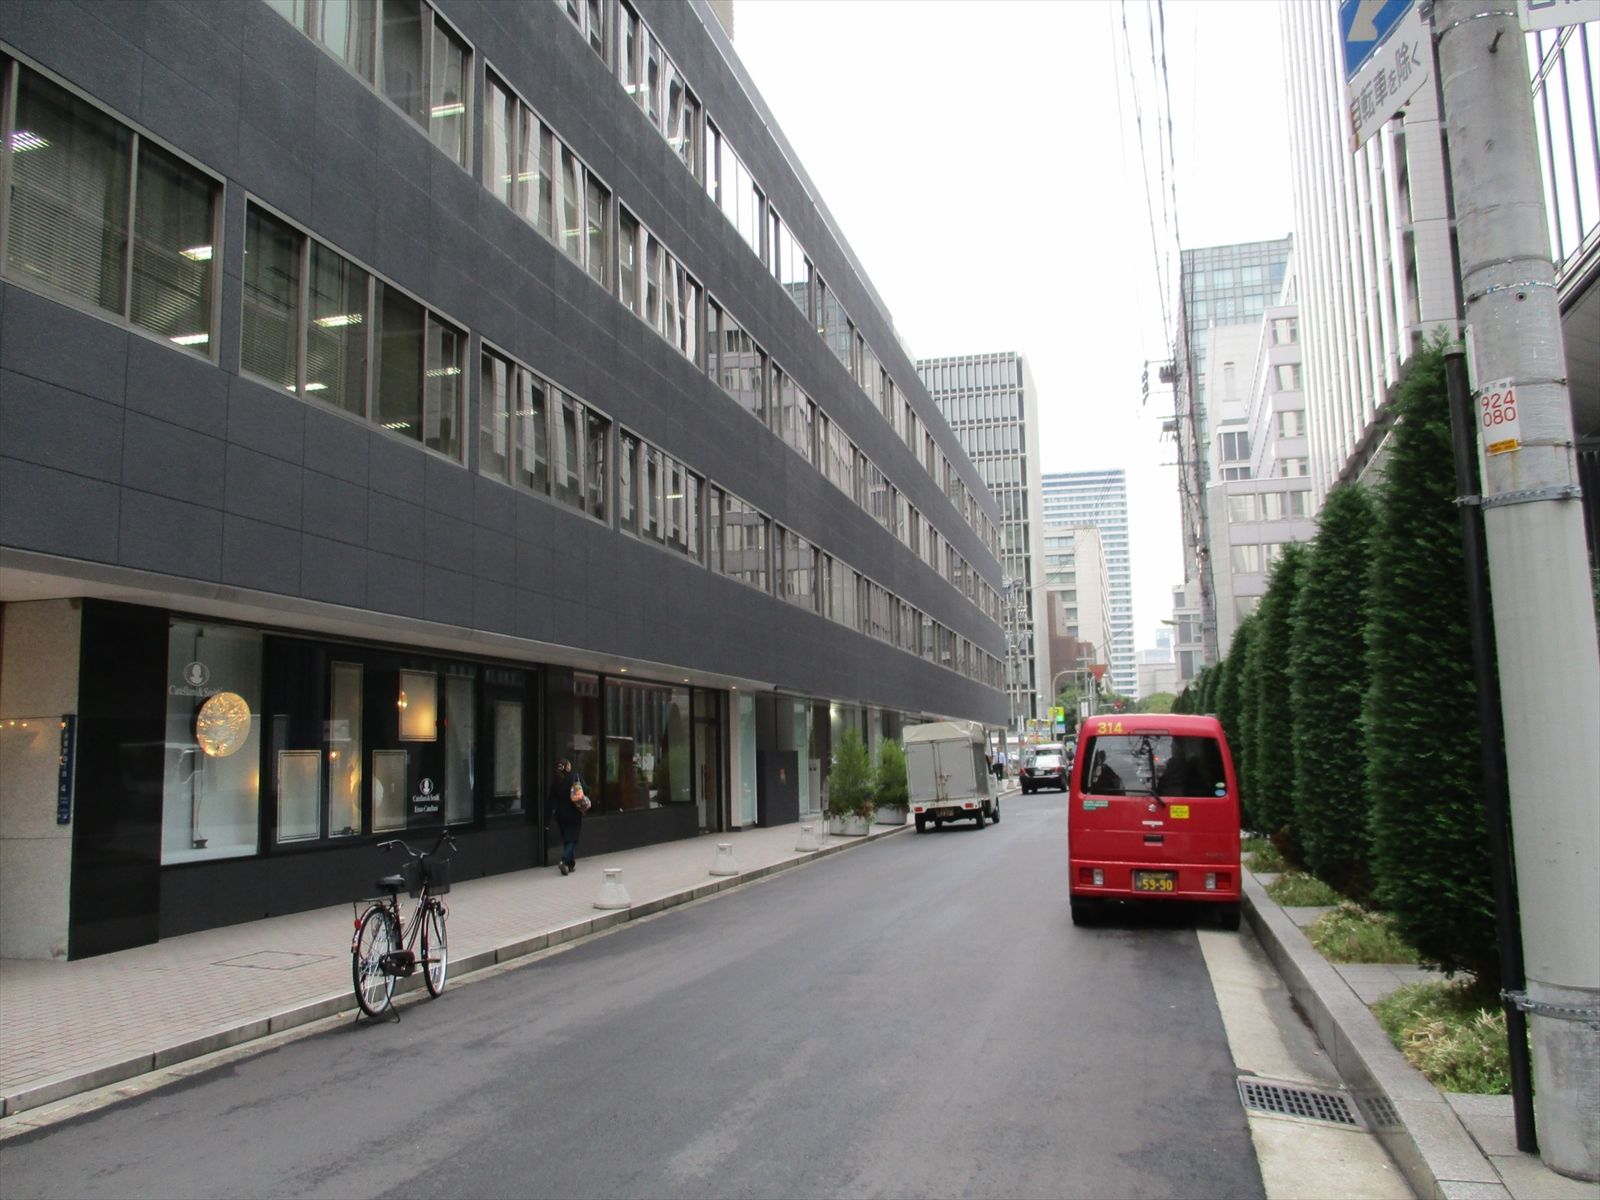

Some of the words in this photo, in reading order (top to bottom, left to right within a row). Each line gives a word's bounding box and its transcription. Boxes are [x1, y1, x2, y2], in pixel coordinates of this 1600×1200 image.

[1350, 40, 1421, 135] 自転車を除く
[1481, 390, 1515, 411] 924
[1482, 406, 1516, 427] 080
[1097, 721, 1123, 734] 314
